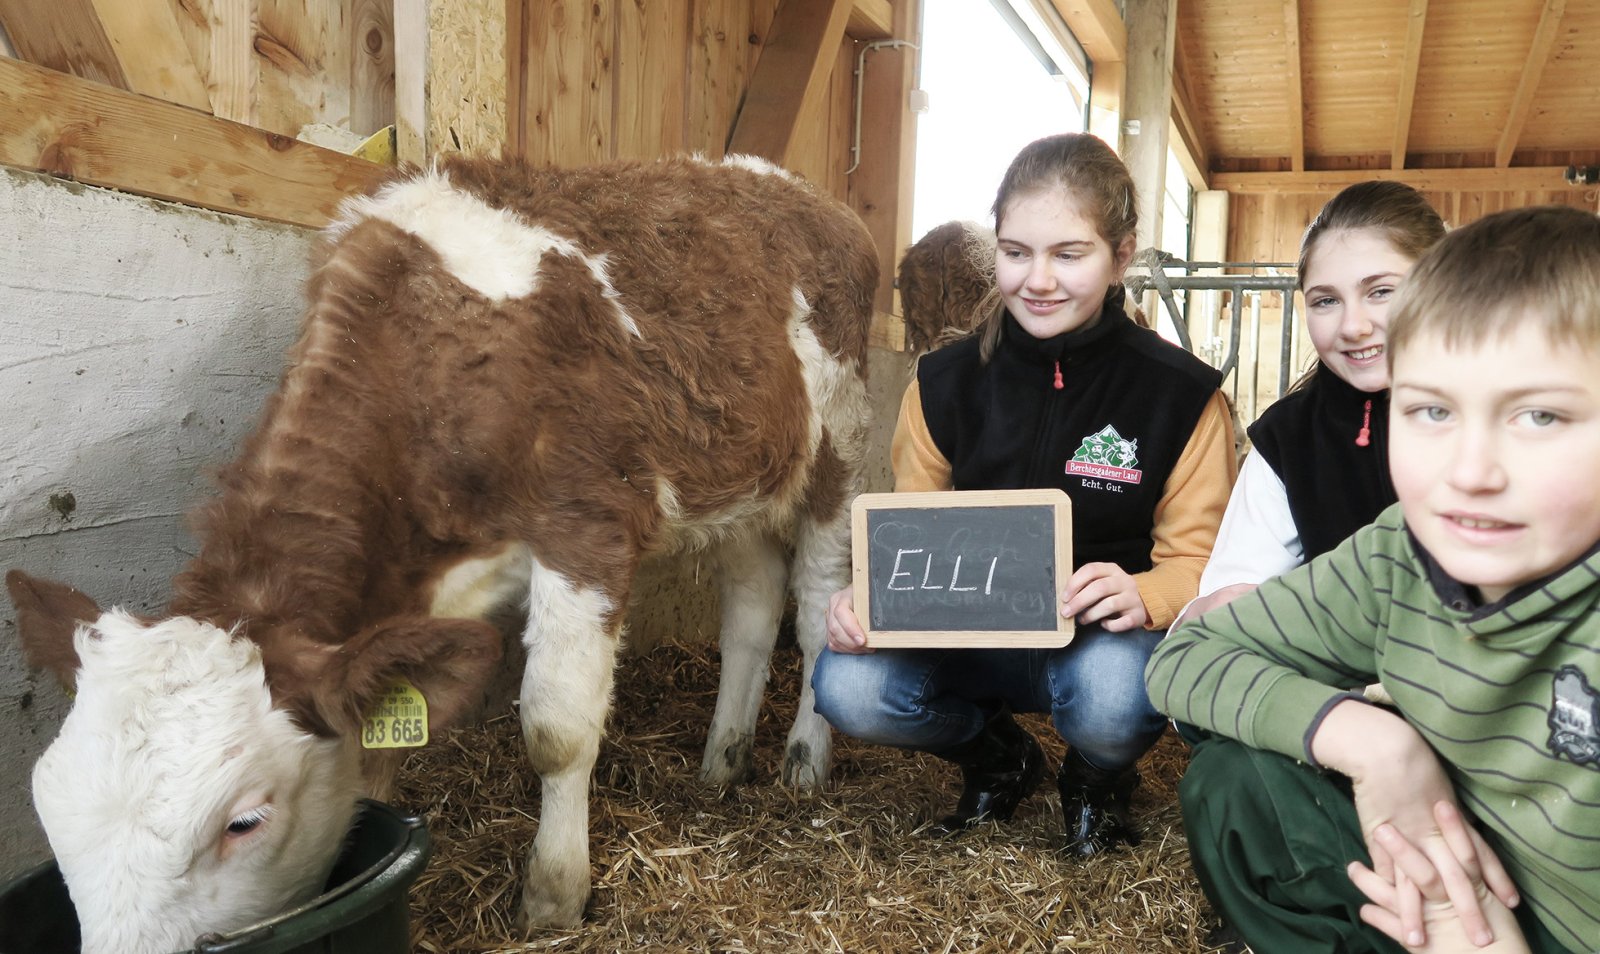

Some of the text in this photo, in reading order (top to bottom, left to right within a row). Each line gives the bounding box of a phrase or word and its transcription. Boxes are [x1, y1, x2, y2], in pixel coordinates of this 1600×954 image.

[1070, 463, 1138, 481] Berchtesgadener Land
[1082, 479, 1123, 493] Echt. Gut.
[887, 548, 998, 595] ELLI
[365, 718, 424, 744] 83 665
